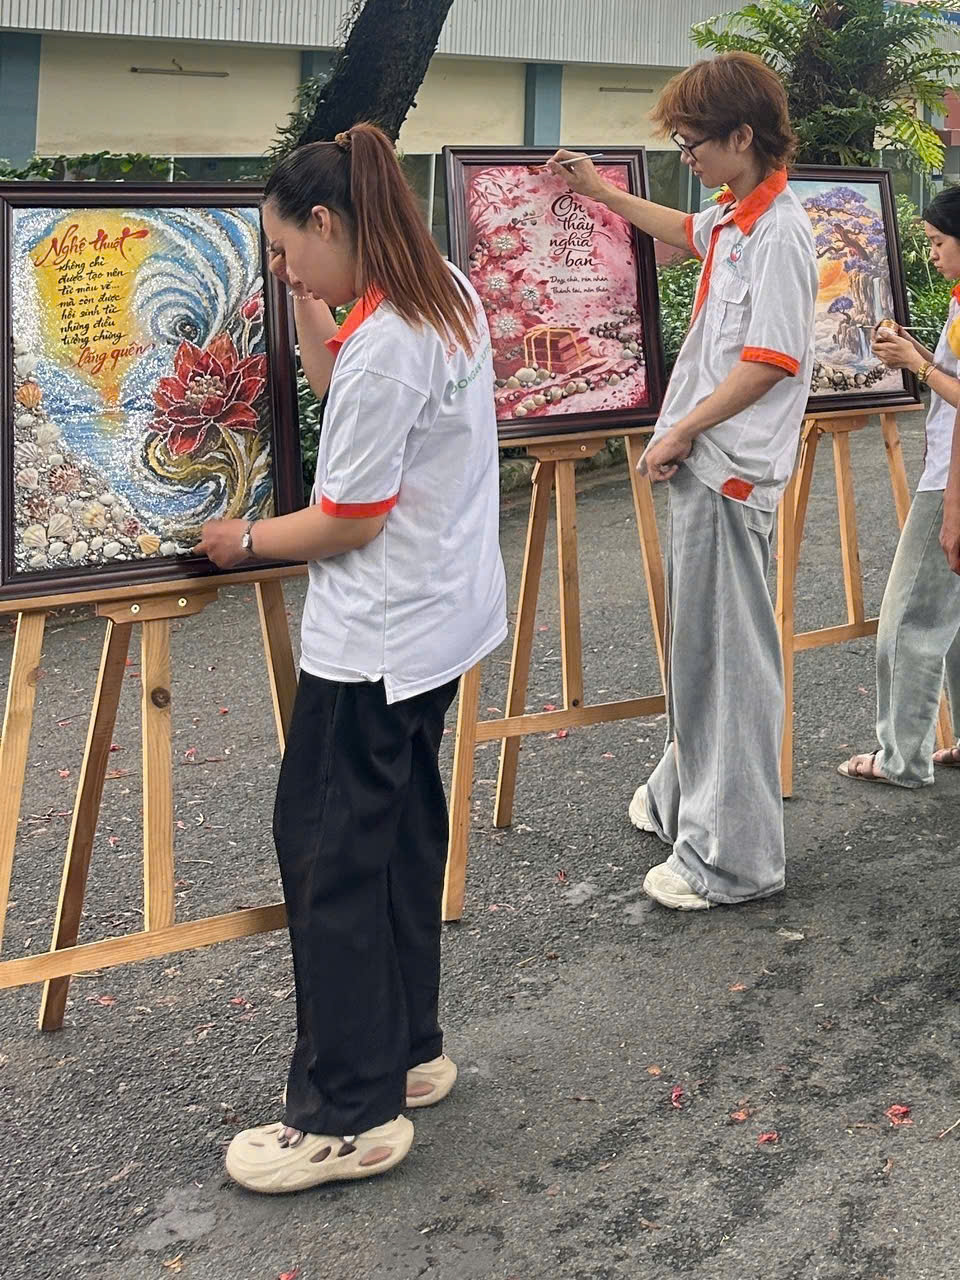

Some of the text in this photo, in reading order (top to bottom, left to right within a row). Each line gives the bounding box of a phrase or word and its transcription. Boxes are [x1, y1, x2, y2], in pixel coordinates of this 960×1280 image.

[557, 213, 612, 240] thầy
[34, 224, 149, 267] Nghệ thuật
[549, 232, 593, 256] nghĩa
[56, 259, 86, 275] không
[565, 251, 608, 270] bạn
[57, 267, 129, 285] được tạo nên
[57, 285, 74, 296] từ
[75, 283, 98, 294] màu
[56, 292, 125, 308] mà còn được
[61, 304, 121, 321] hồi sinh từ
[60, 315, 116, 336] những điều
[61, 329, 128, 349] tưởng chừng
[110, 341, 156, 372] quên
